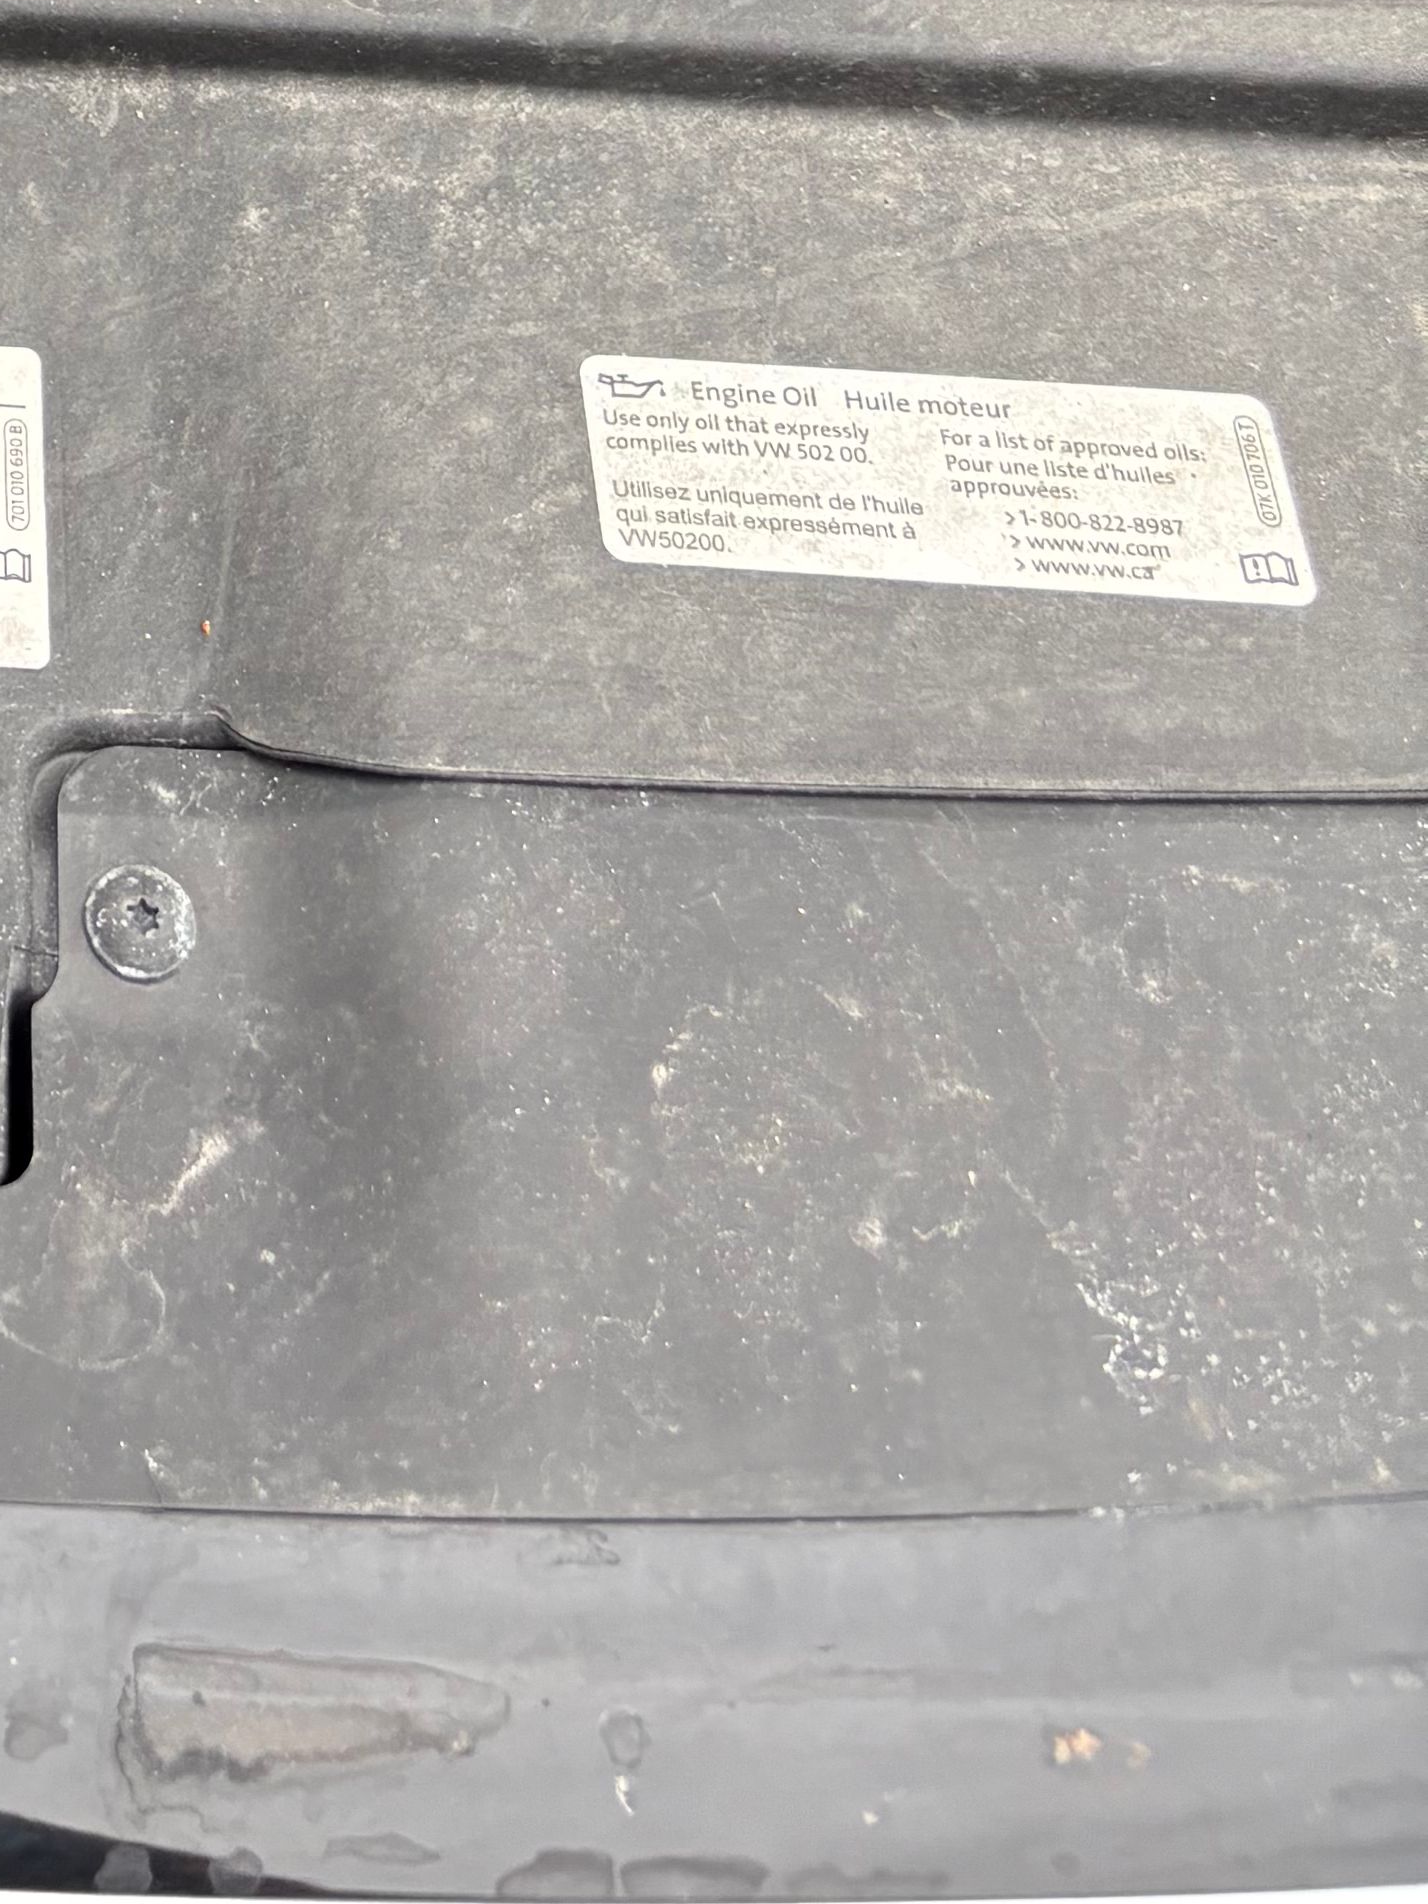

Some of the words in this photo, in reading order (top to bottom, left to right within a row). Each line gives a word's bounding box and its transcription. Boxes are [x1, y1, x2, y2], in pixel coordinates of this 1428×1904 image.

[690, 380, 777, 410] Engine
[781, 385, 817, 407] Oil
[843, 389, 911, 412] Huile
[916, 395, 1013, 419] moteur
[9, 425, 22, 434] B
[602, 408, 640, 426] Use
[644, 409, 691, 433] only
[693, 412, 720, 431] oil
[724, 414, 770, 434] that
[772, 417, 871, 444] expressly
[9, 438, 23, 467] 690
[604, 431, 698, 458] complies
[701, 437, 749, 456] with
[753, 440, 793, 459] VW
[796, 443, 835, 462] 502
[838, 445, 874, 464] 00.
[939, 429, 973, 447] For
[977, 434, 991, 448] a
[994, 431, 1030, 451] list
[1031, 433, 1057, 452] of
[1057, 435, 1159, 463] approved
[1161, 441, 1207, 462] oils:
[1240, 433, 1261, 461] 706
[9, 470, 24, 495] 010
[944, 453, 994, 473] Pour
[998, 460, 1040, 476] une
[1042, 459, 1090, 479] liste
[1091, 462, 1177, 485] d'huiles
[1248, 464, 1269, 490] 010
[611, 479, 691, 501] Utilisez
[695, 484, 823, 512] uniquement
[826, 492, 856, 511] de
[861, 494, 925, 515] l'huile
[948, 475, 1080, 504] approuvées:
[10, 499, 24, 523] 701
[615, 504, 650, 527] qui
[654, 506, 737, 528] satisfait
[741, 512, 897, 542] expressément
[900, 521, 917, 539] à
[618, 527, 733, 553] VW50200.
[1025, 535, 1171, 558] www.vw.com
[1030, 558, 1155, 580] www.vw.ca
